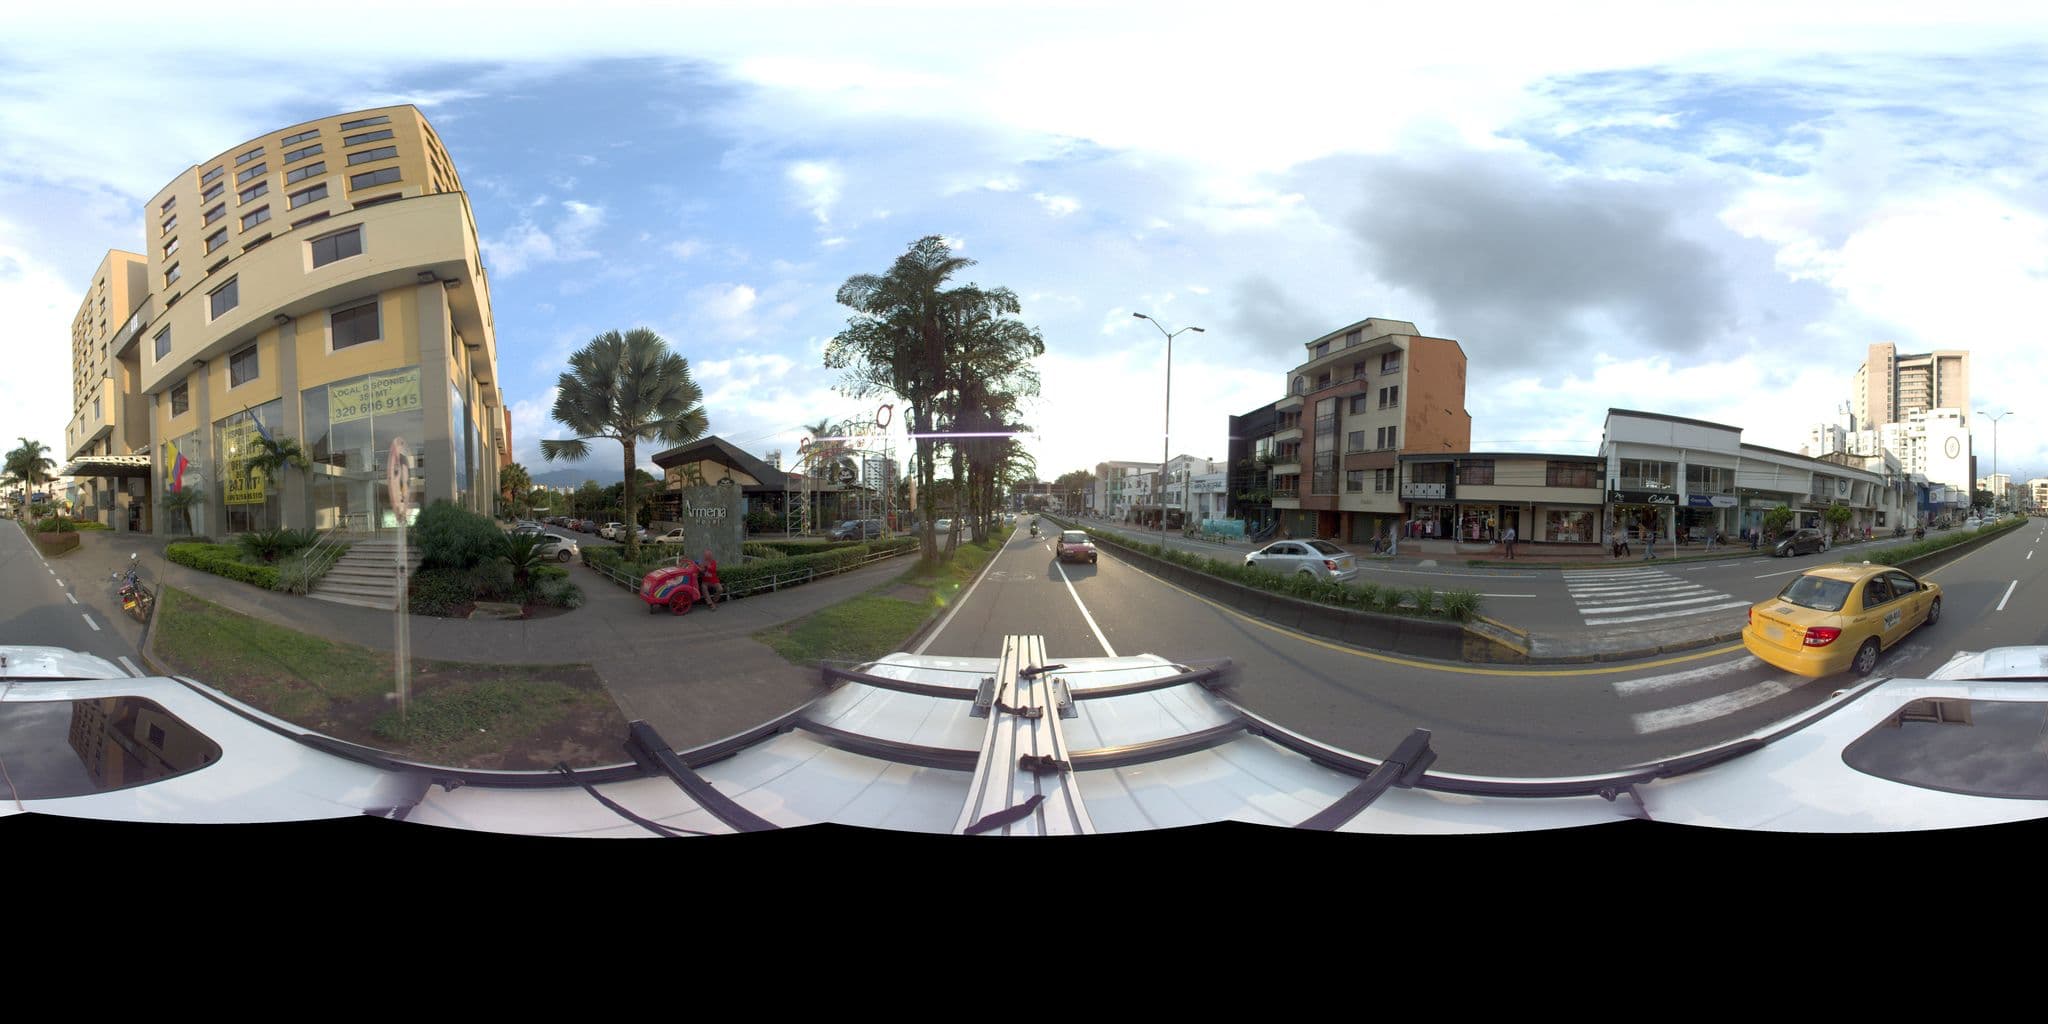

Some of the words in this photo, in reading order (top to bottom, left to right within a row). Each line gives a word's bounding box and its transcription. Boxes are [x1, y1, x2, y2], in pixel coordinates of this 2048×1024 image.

[362, 375, 417, 391] DSPONIBLE
[335, 405, 356, 418] 320
[386, 393, 417, 408] 9115
